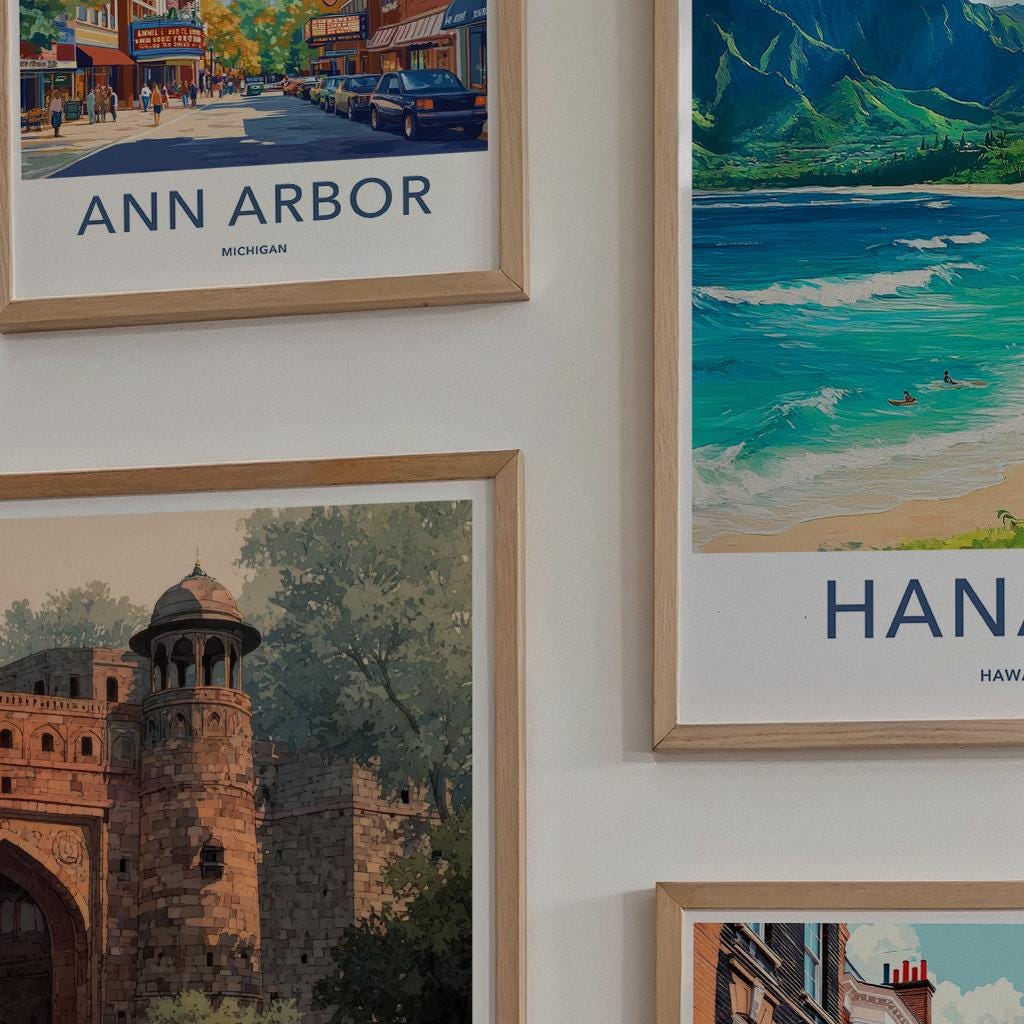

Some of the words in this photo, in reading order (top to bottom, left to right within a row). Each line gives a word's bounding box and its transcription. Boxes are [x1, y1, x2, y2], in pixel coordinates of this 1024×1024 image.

[77, 188, 205, 236] ANN
[228, 175, 432, 227] ARBOR
[221, 244, 288, 257] MICHIGAN
[827, 577, 1024, 639] HAN
[980, 669, 1024, 682] HAW
